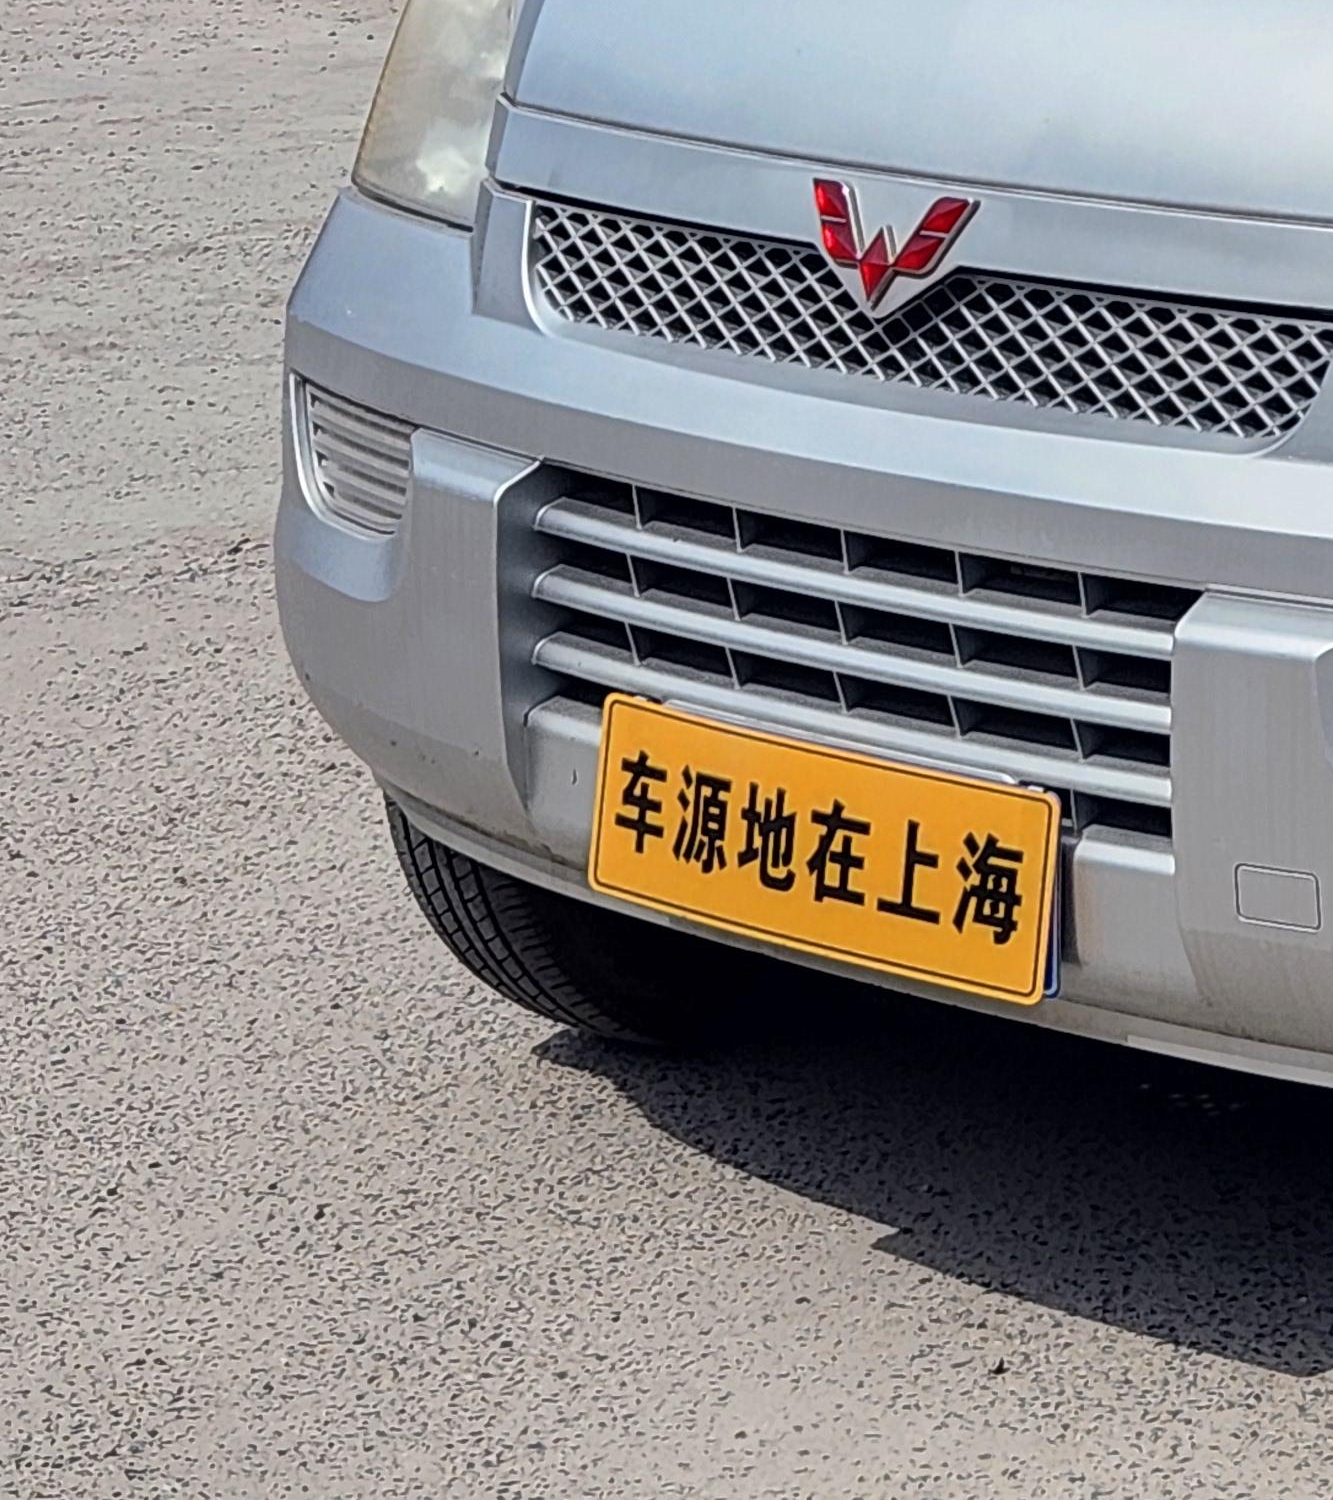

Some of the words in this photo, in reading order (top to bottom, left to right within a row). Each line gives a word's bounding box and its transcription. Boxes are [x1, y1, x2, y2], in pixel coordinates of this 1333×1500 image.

[615, 750, 1024, 946] 车源地在上海
